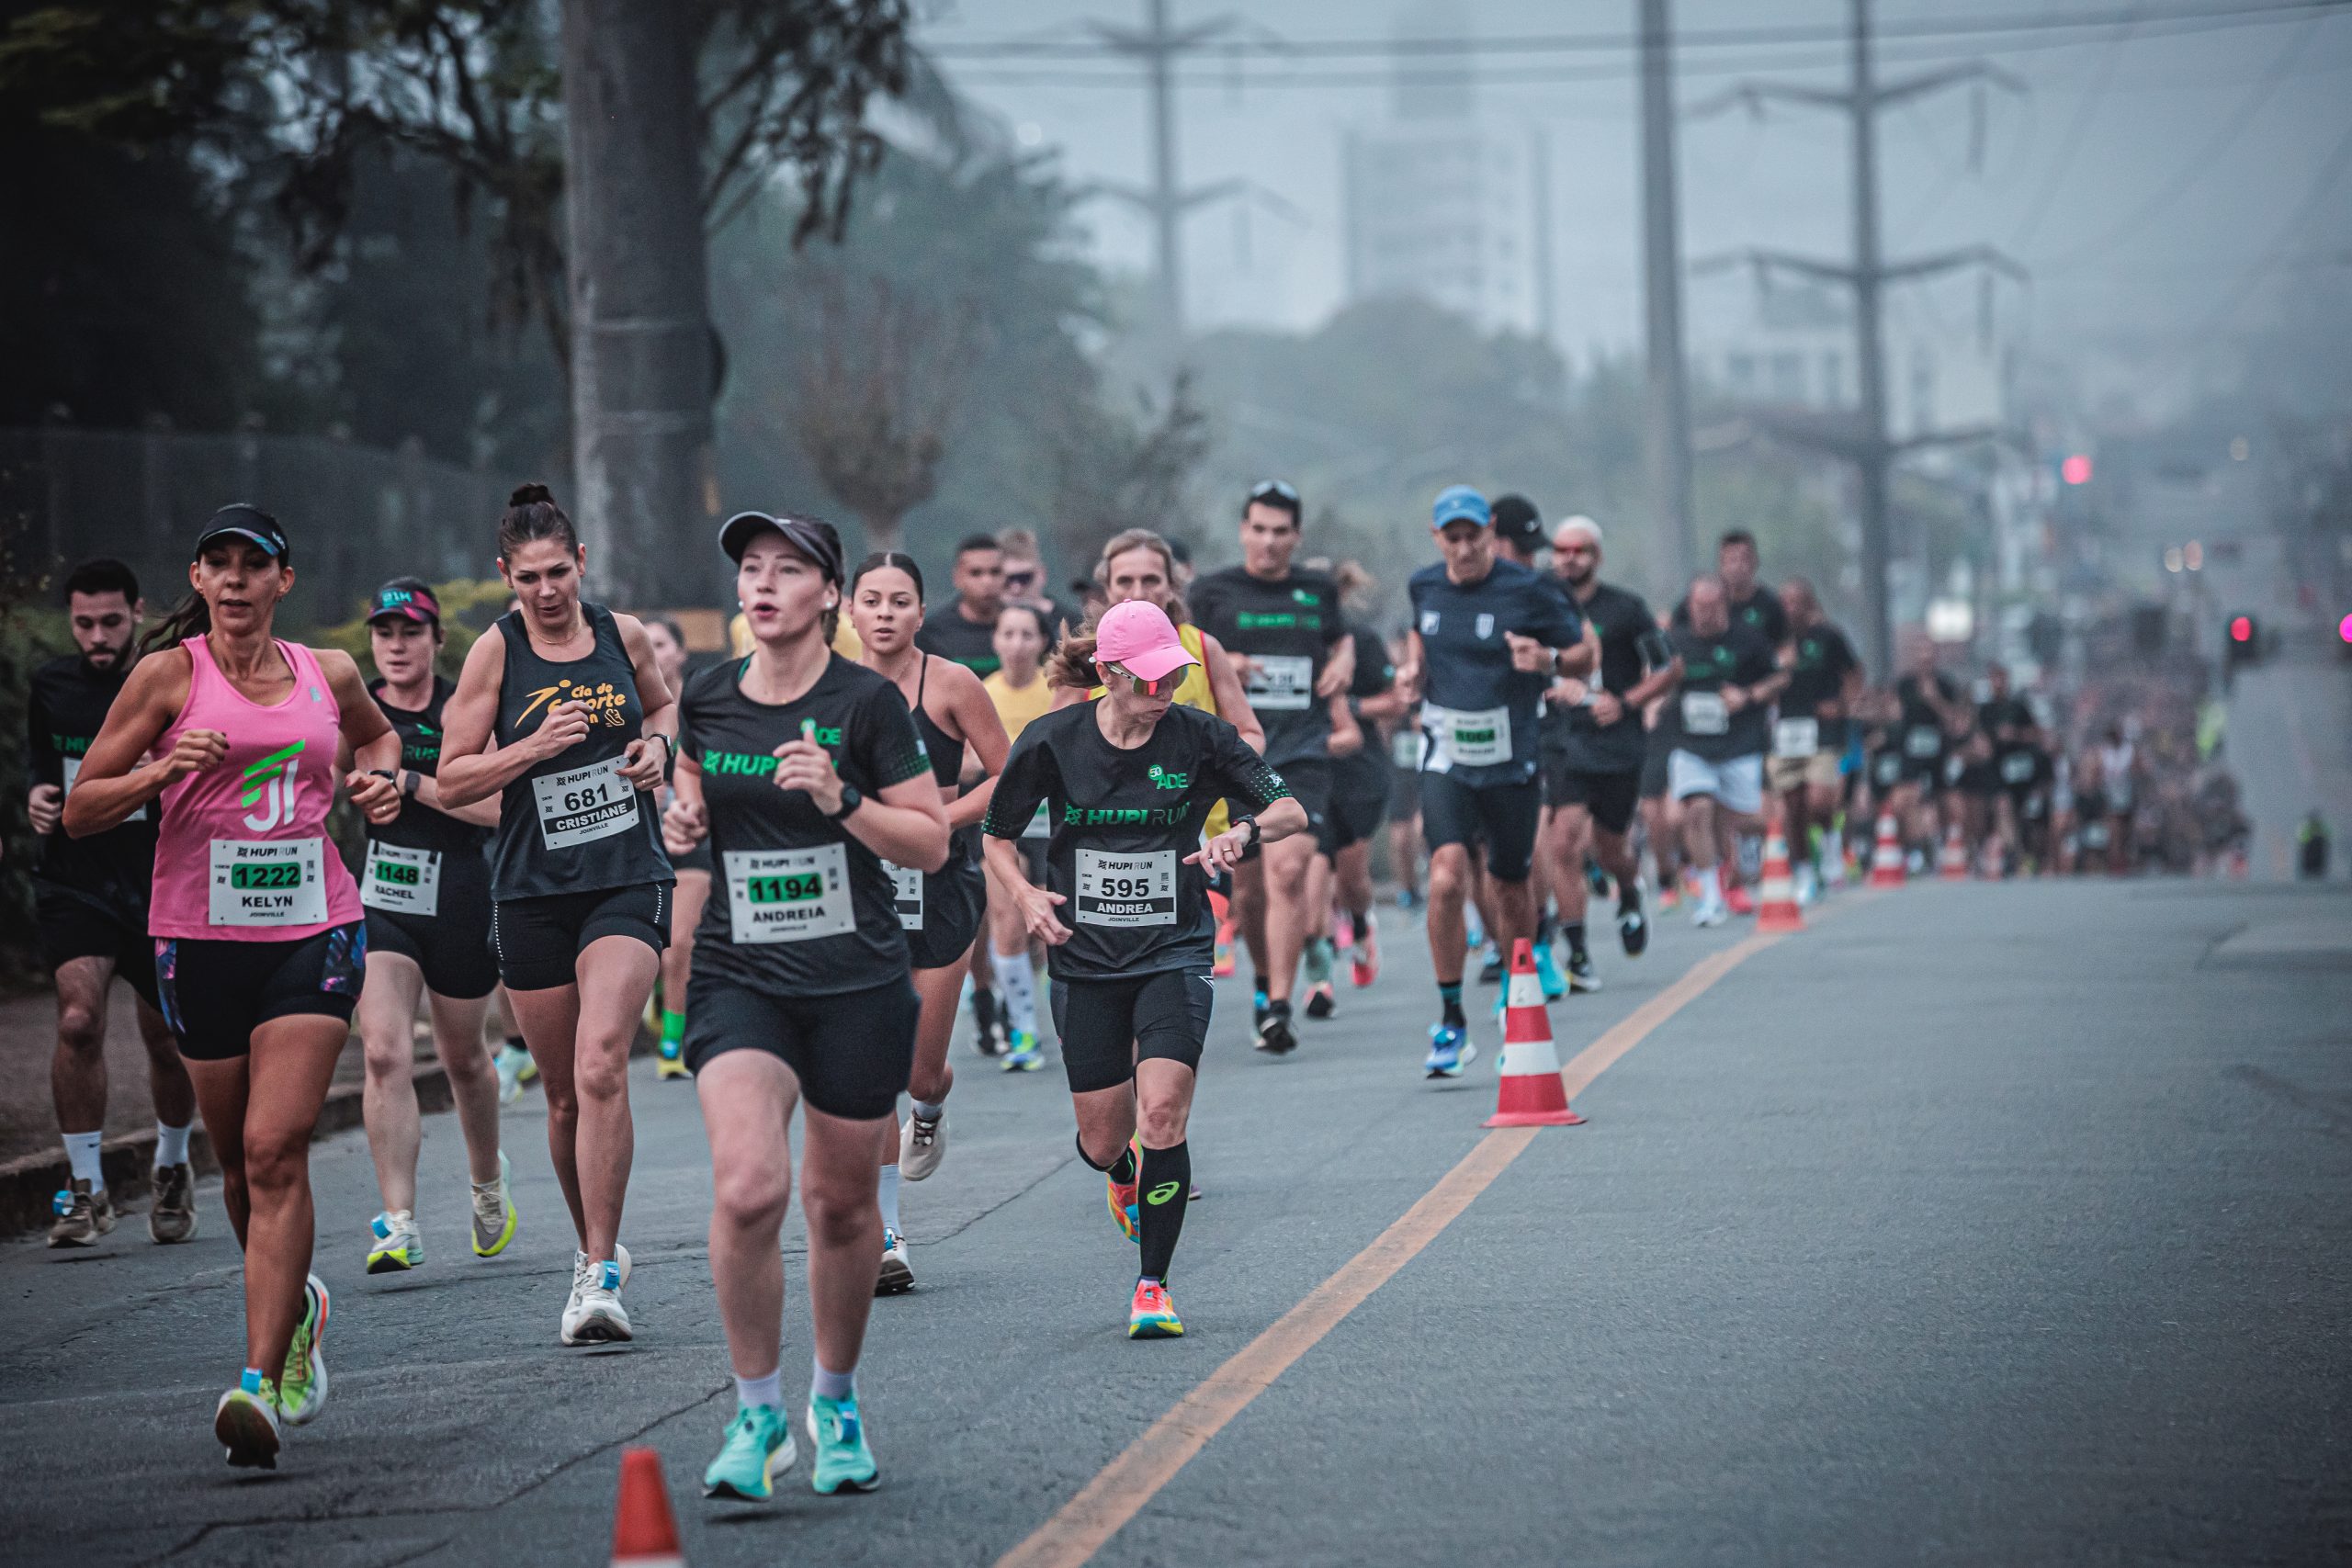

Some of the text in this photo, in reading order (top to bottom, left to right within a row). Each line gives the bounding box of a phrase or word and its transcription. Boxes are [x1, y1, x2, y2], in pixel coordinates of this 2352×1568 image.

[596, 683, 614, 694] do
[548, 694, 626, 714] Eorte
[720, 752, 785, 776] HUP
[568, 765, 608, 784] HUPI RUN
[1156, 773, 1189, 790] ADE
[564, 783, 608, 811] 681
[556, 803, 628, 831] CRISTIANE
[1086, 808, 1148, 825] HUPI
[579, 822, 608, 835] JOINVILLE
[250, 846, 298, 857] HUPI RUN
[377, 863, 418, 884] 1148
[1108, 861, 1153, 871] HUPI RUN
[235, 865, 300, 887] 1222
[375, 885, 416, 900] RACHEL
[750, 874, 822, 901] 1194
[1101, 877, 1149, 898] 595
[242, 896, 293, 908] KELYN
[1096, 901, 1154, 915] ANDREA
[752, 906, 826, 923] ANDREIA
